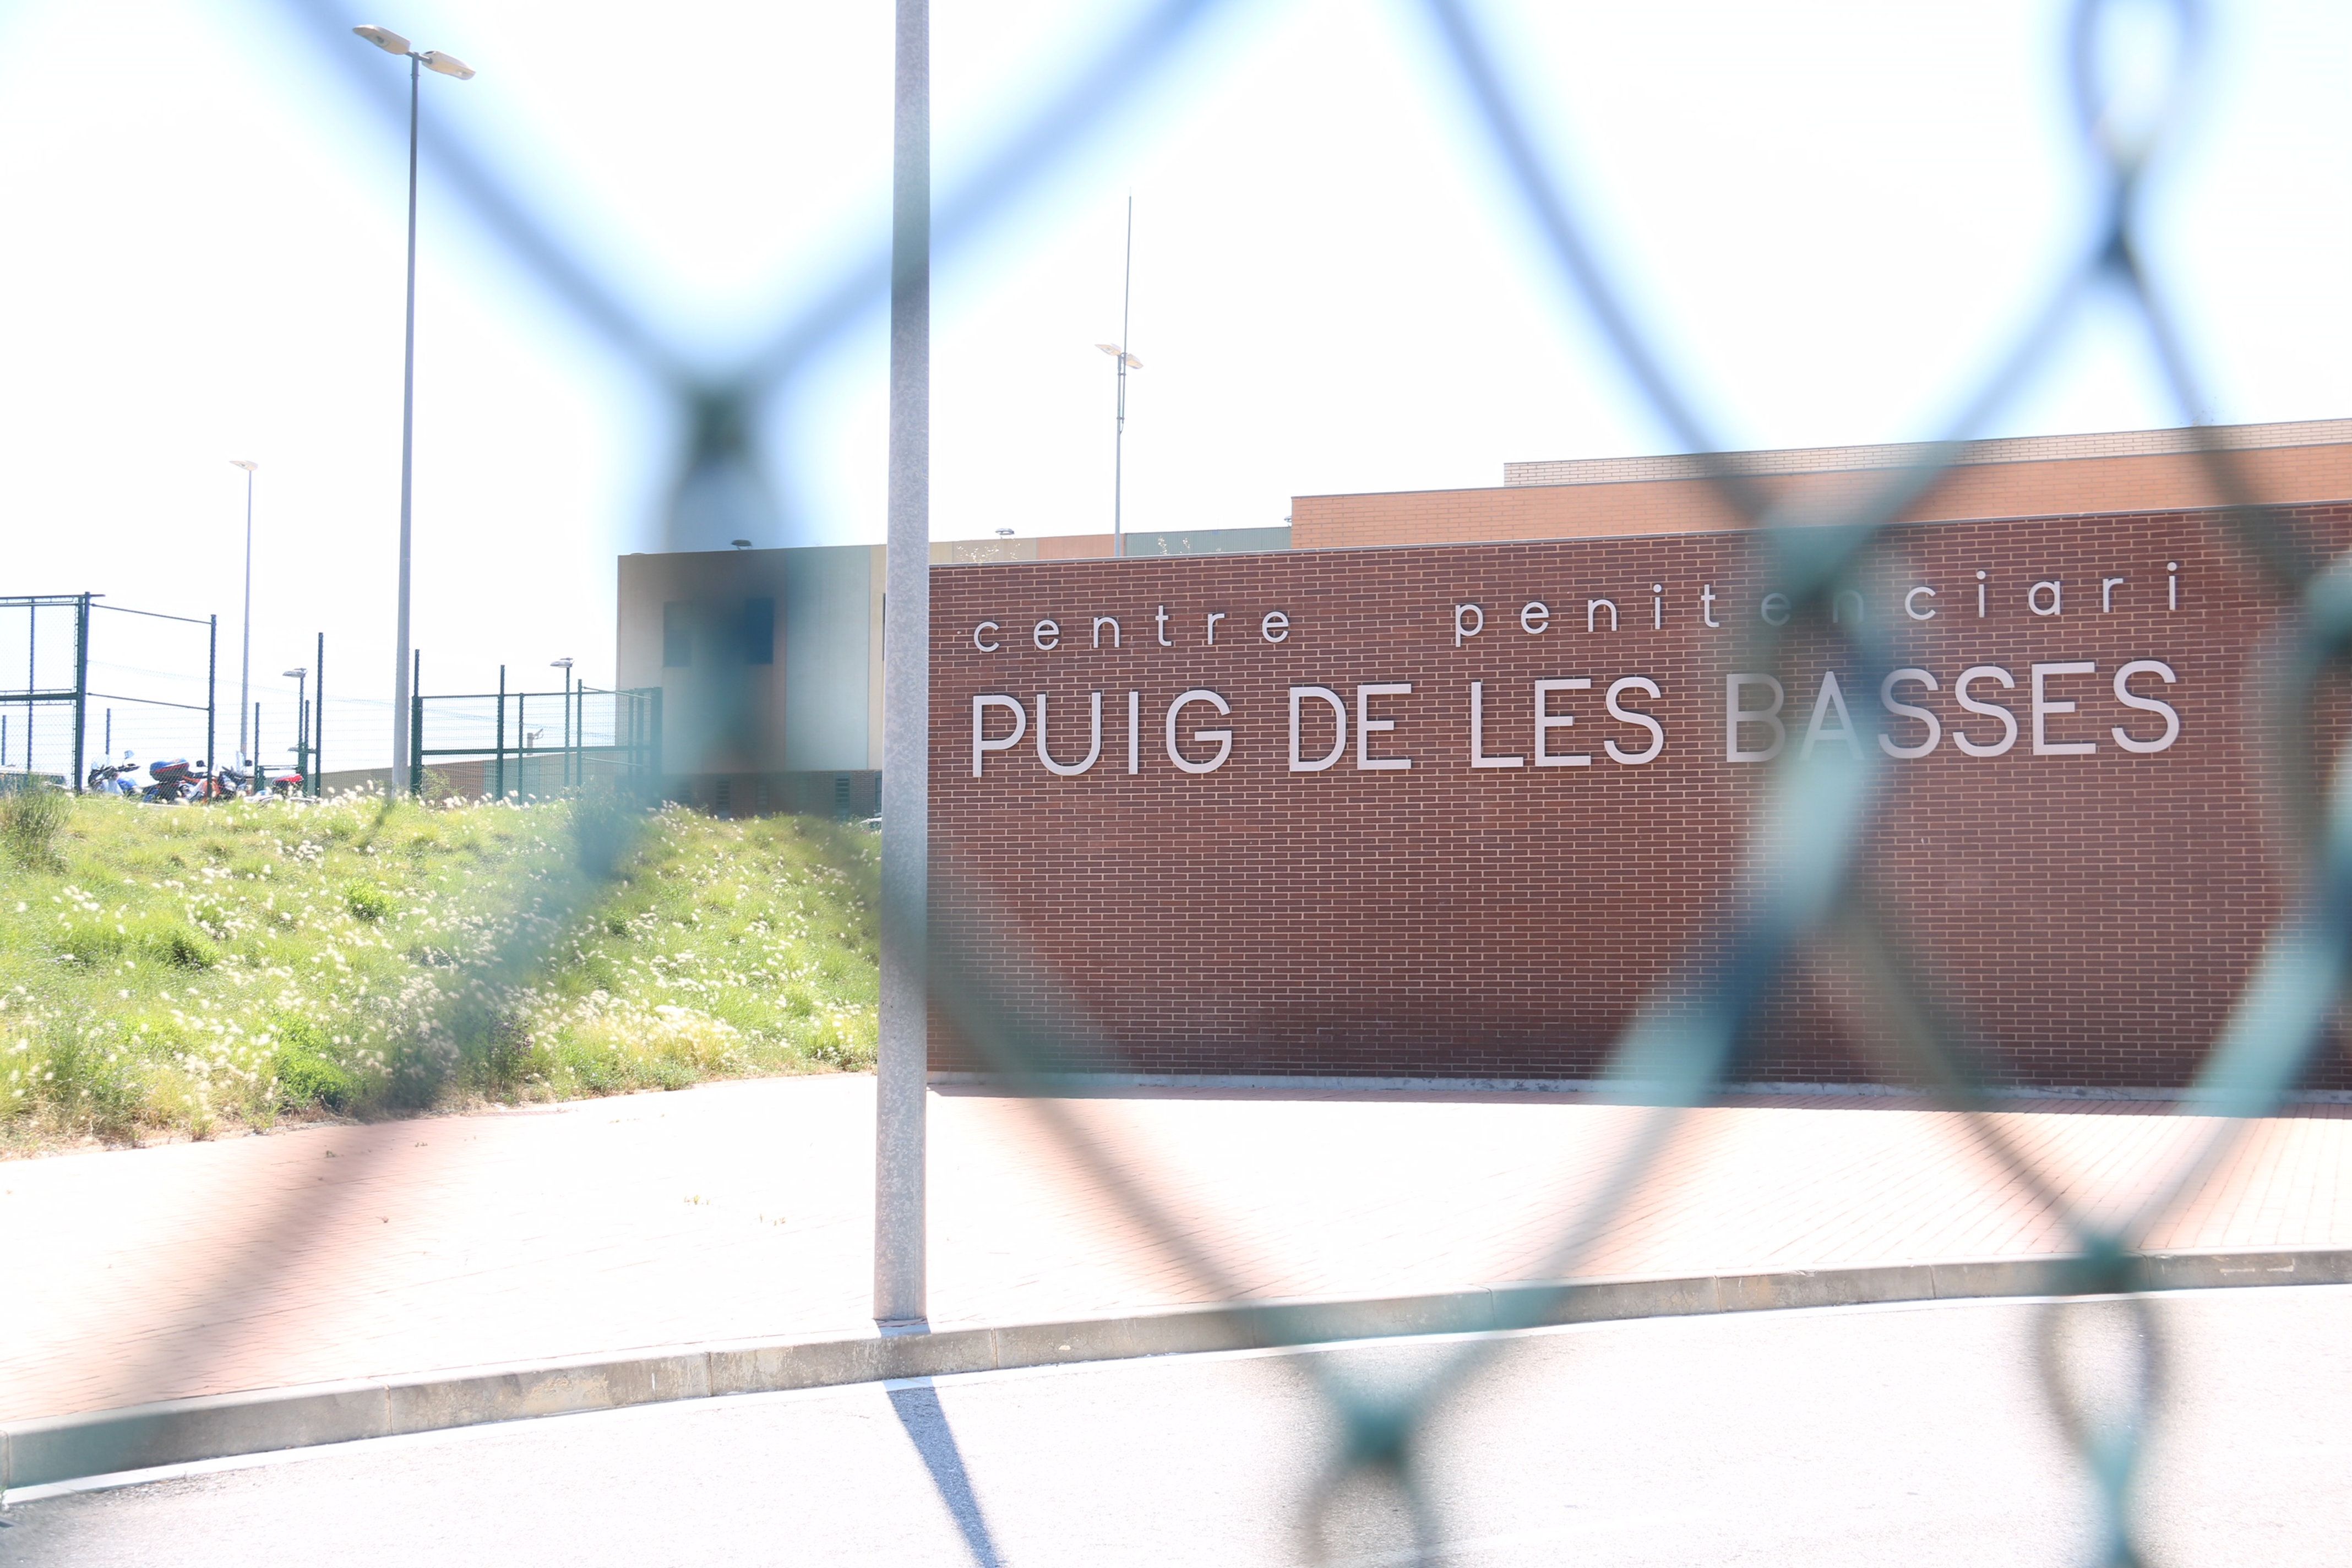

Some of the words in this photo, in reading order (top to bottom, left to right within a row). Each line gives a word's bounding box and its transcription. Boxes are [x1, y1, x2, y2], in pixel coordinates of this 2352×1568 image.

[973, 605, 1289, 652] centre
[1455, 562, 2177, 647] penitenciari
[973, 689, 1232, 777] PUIG
[1289, 684, 1412, 771] DE
[1471, 677, 1664, 767] LES
[1726, 660, 2180, 763] BASSES
